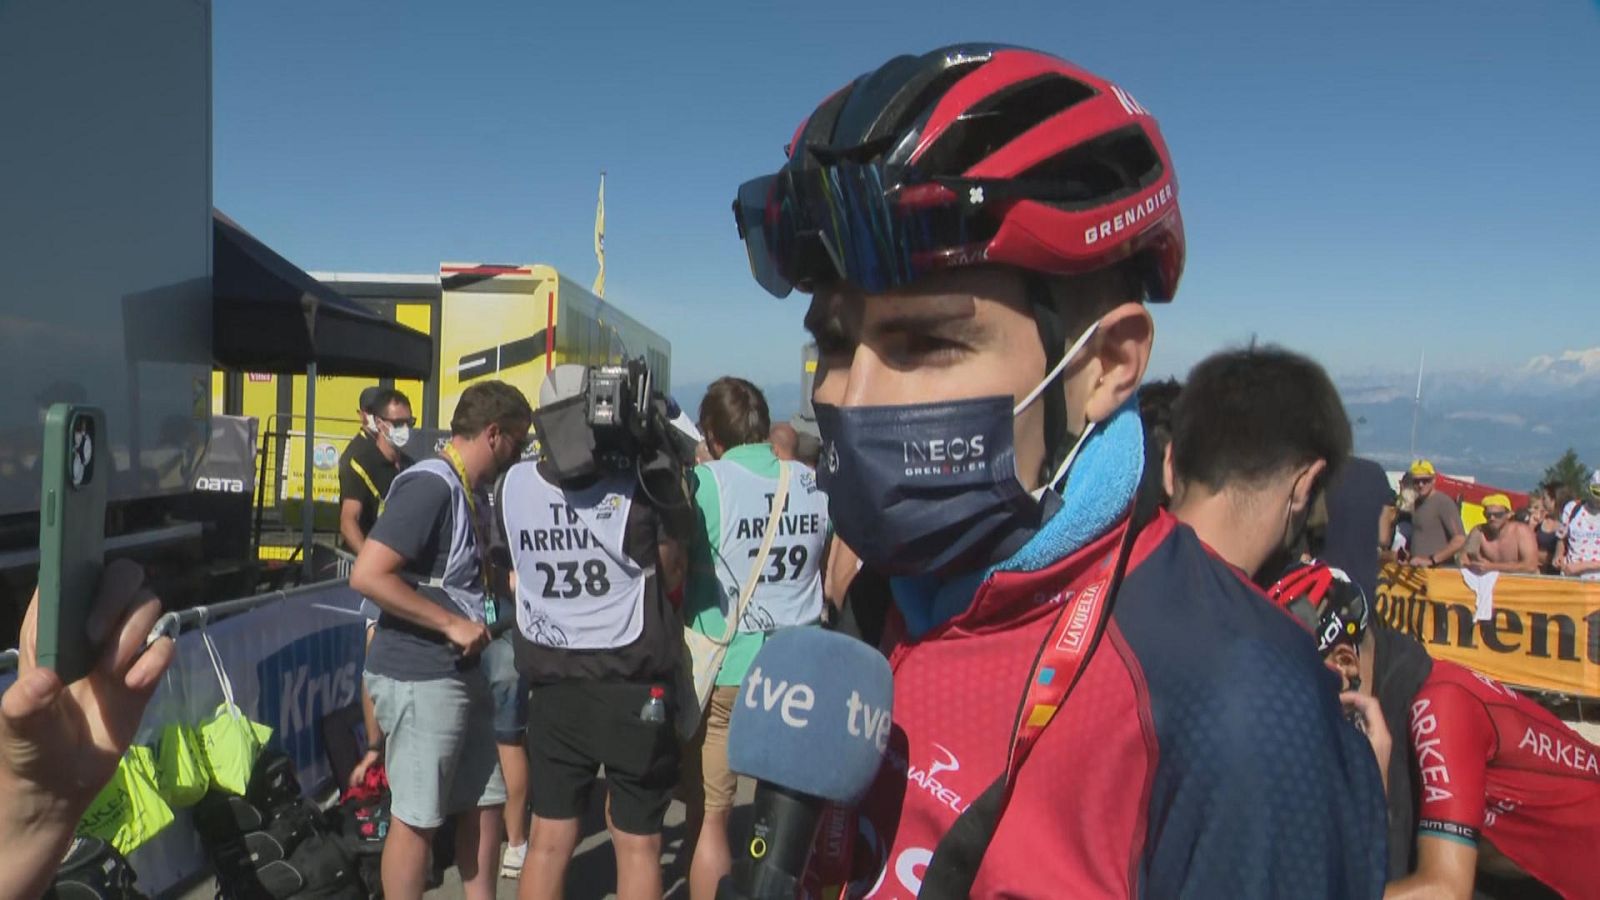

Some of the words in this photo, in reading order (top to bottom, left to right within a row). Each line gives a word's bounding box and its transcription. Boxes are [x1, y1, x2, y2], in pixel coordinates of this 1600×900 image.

[1084, 184, 1173, 245] GRENADIER
[903, 434, 985, 464] INEOS
[905, 462, 986, 476] GRENADIER
[520, 525, 601, 551] ARRIV
[535, 558, 611, 600] 238
[745, 666, 816, 729] tve
[846, 690, 893, 755] tve
[1411, 699, 1454, 803] ARKEA
[1518, 727, 1600, 775] ARKEA
